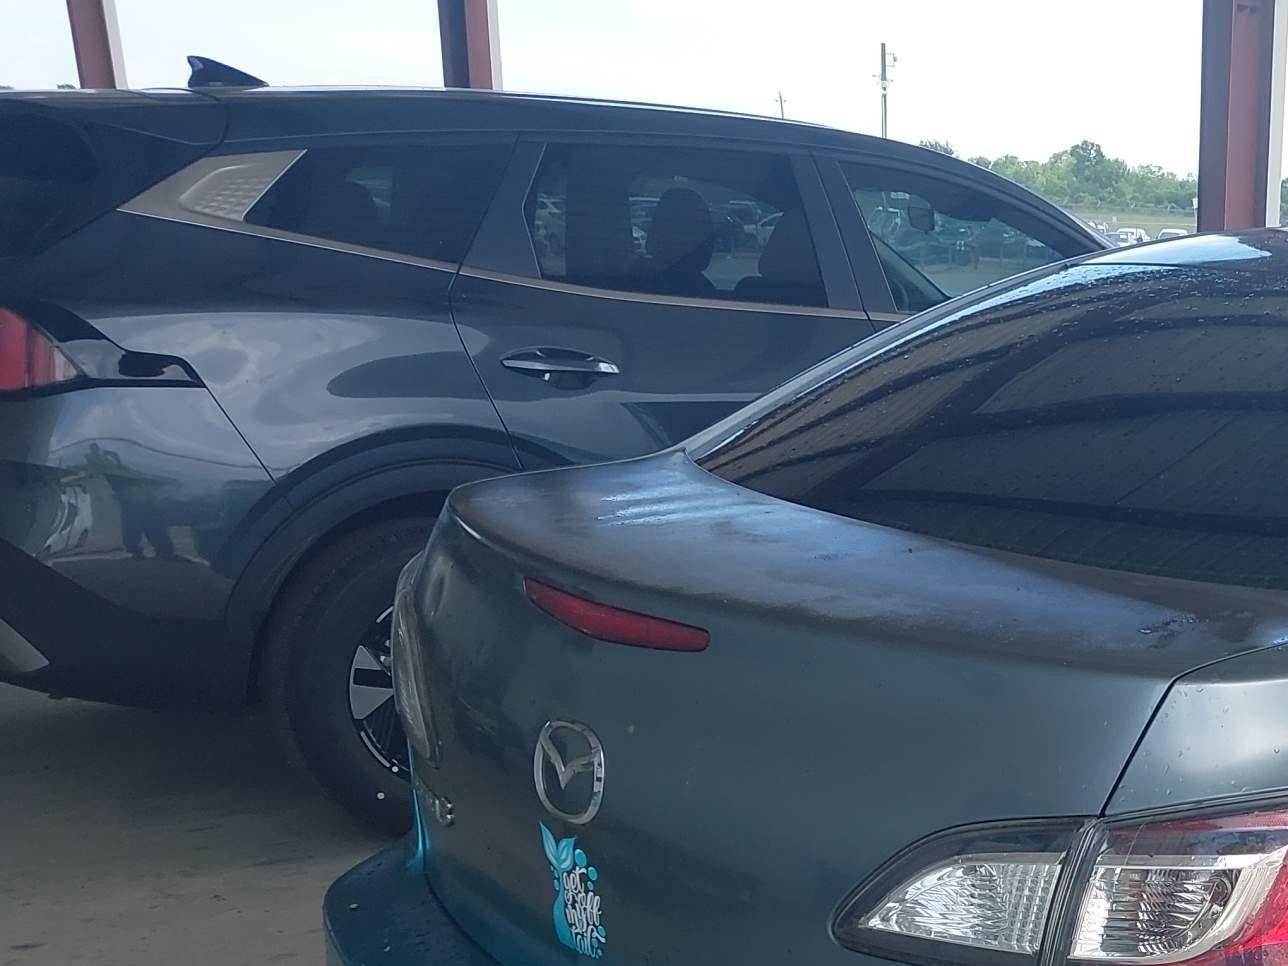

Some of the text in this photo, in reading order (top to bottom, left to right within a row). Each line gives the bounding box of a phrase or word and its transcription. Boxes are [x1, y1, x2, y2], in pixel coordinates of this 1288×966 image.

[563, 866, 587, 905] get
[566, 904, 587, 933] my
[578, 891, 602, 926] off
